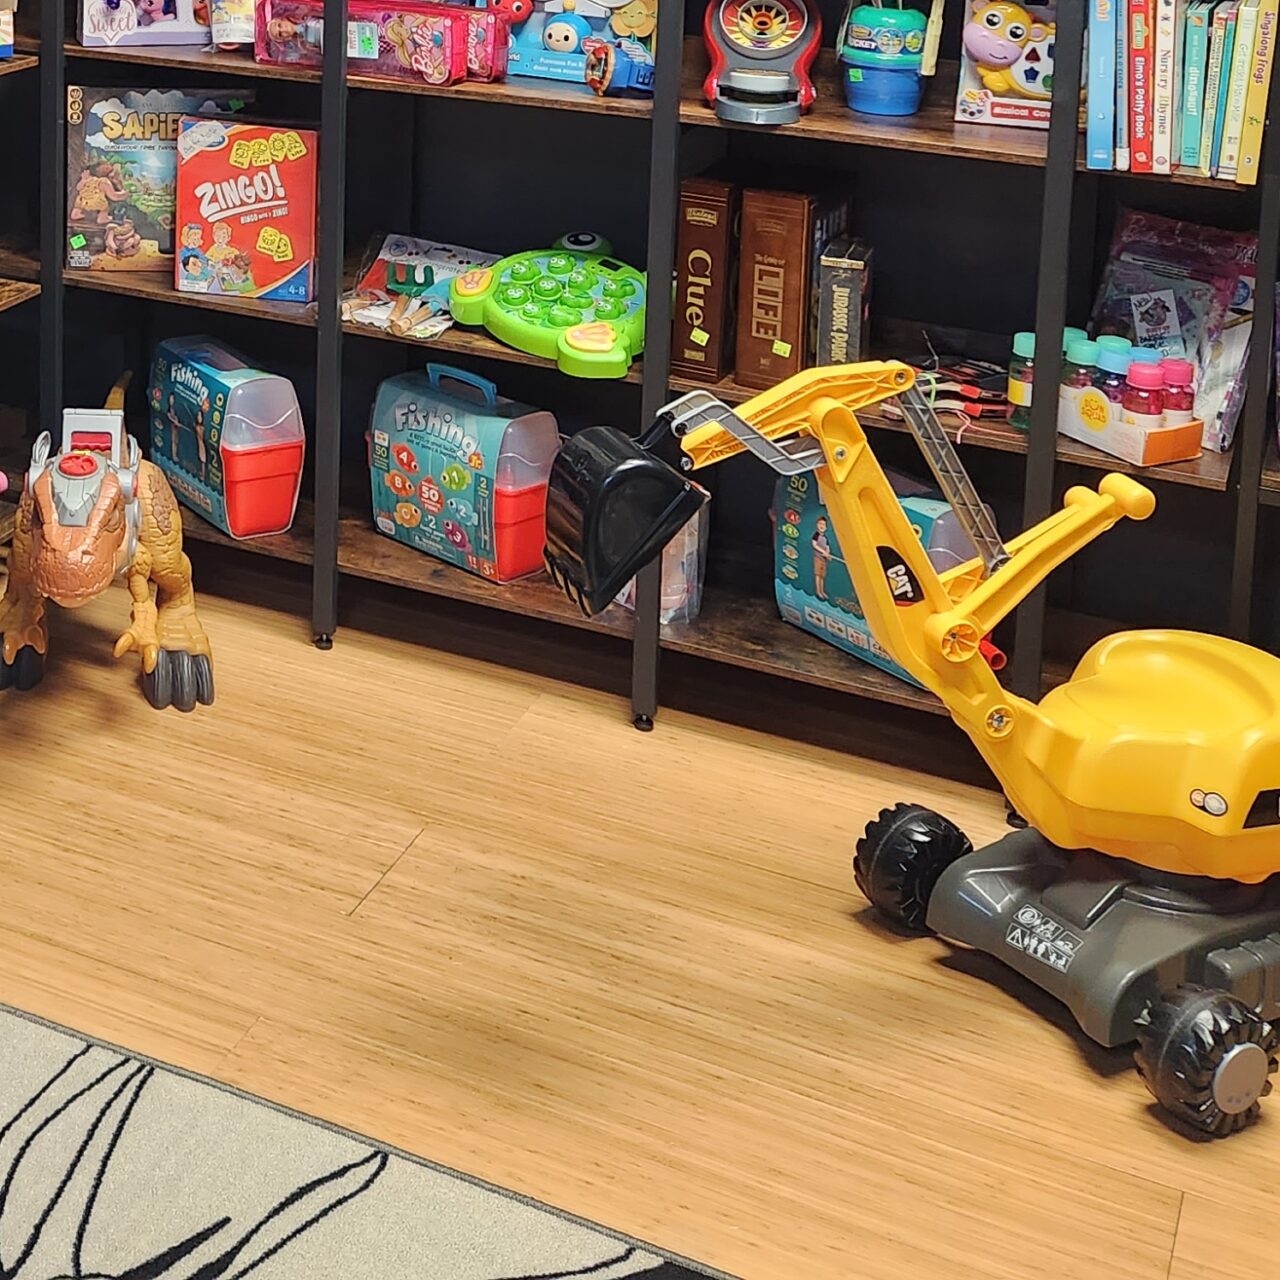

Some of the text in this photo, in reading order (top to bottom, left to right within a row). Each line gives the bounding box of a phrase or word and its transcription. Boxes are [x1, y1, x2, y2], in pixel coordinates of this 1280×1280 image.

[411, 22, 434, 74] Barbie
[1254, 11, 1276, 85] Singalong frogs
[1134, 56, 1145, 88] Elmo's
[1133, 88, 1145, 113] Potty
[1157, 49, 1173, 135] Nursery Rhymes
[1135, 114, 1144, 139] Book
[194, 164, 287, 218] ZINGO!
[288, 286, 305, 296] 4-8
[685, 249, 713, 326] Clue
[752, 264, 784, 340] LIFE
[830, 284, 851, 363] JURASSIC PARK
[170, 363, 210, 407] Fishing
[395, 403, 481, 464] Fishing
[375, 445, 387, 458] 50
[400, 451, 408, 464] A
[394, 476, 402, 488] B
[451, 470, 459, 483] 1
[479, 477, 488, 489] 2
[790, 476, 808, 492] 50
[421, 486, 439, 501] 50
[402, 508, 410, 520] C
[458, 506, 466, 518] 2
[453, 531, 462, 543] 3
[886, 564, 913, 599] CAT
